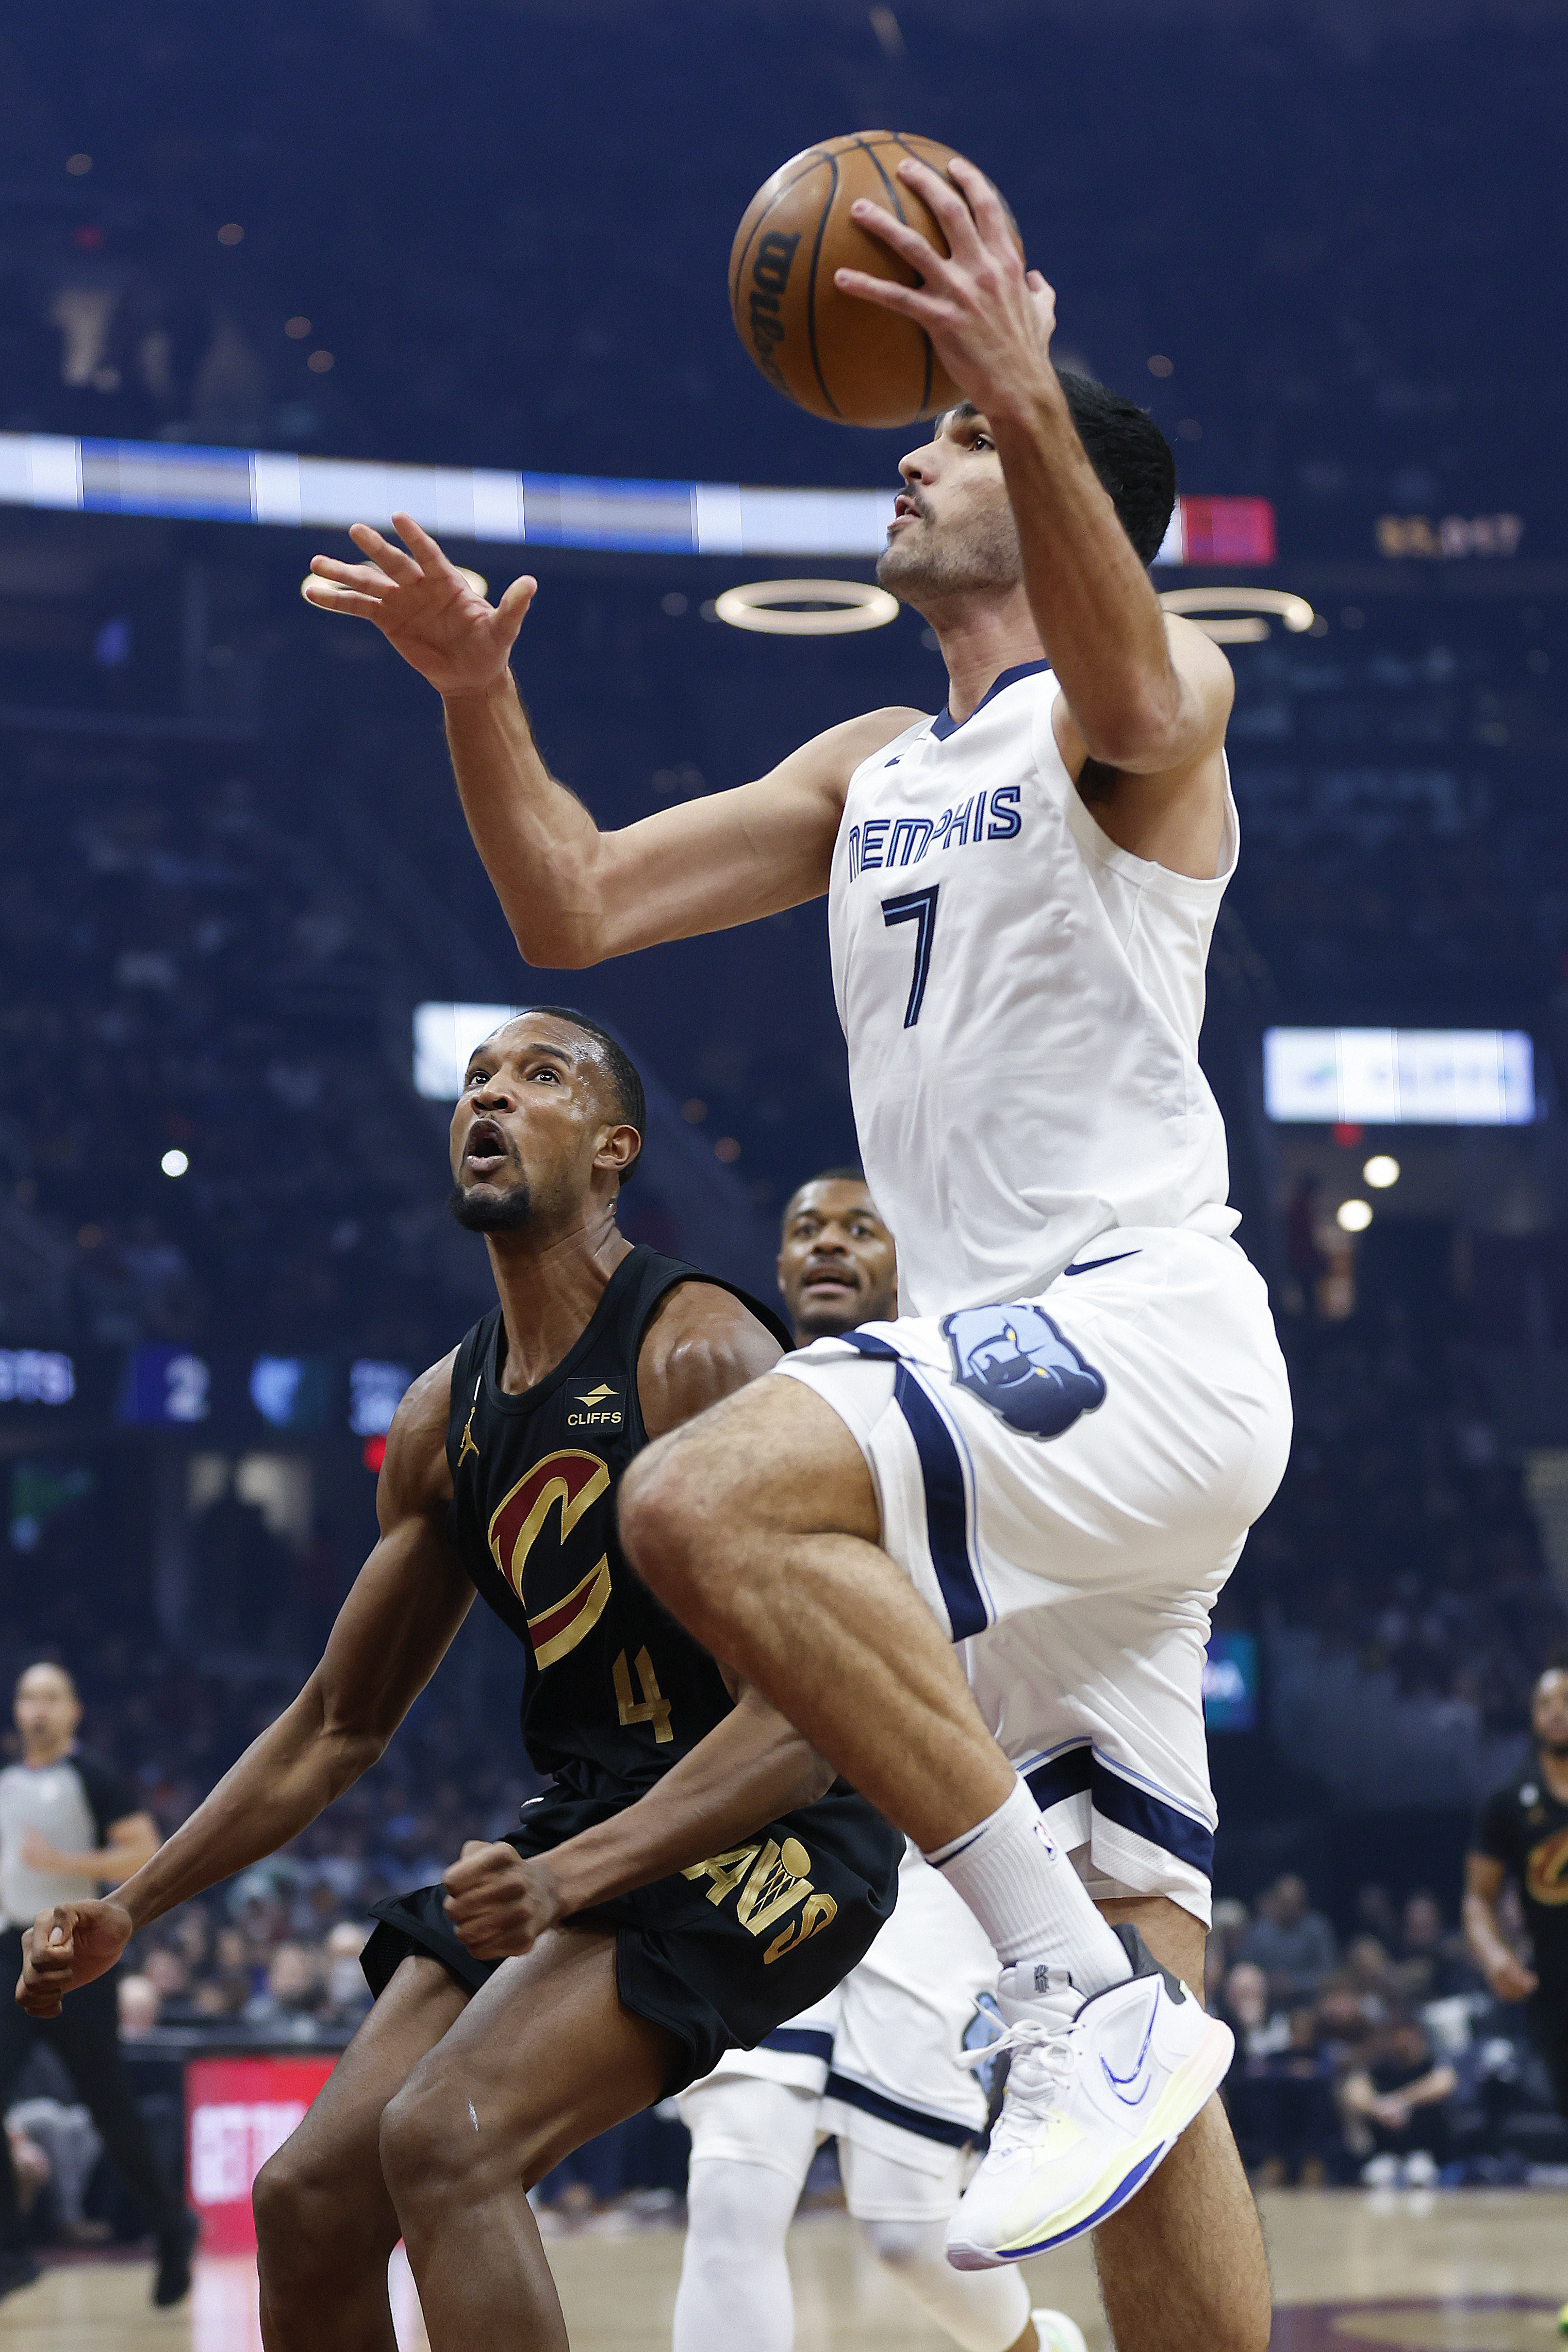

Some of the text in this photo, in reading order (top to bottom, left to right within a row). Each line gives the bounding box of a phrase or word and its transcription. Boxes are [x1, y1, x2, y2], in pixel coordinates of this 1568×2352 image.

[849, 785, 1021, 883] MEMPHIS
[881, 883, 939, 1029] 7
[568, 1412, 622, 1426] CLIFFS
[488, 1449, 612, 1671] C
[612, 1645, 673, 1744] 4
[680, 1837, 838, 1965] AVS
